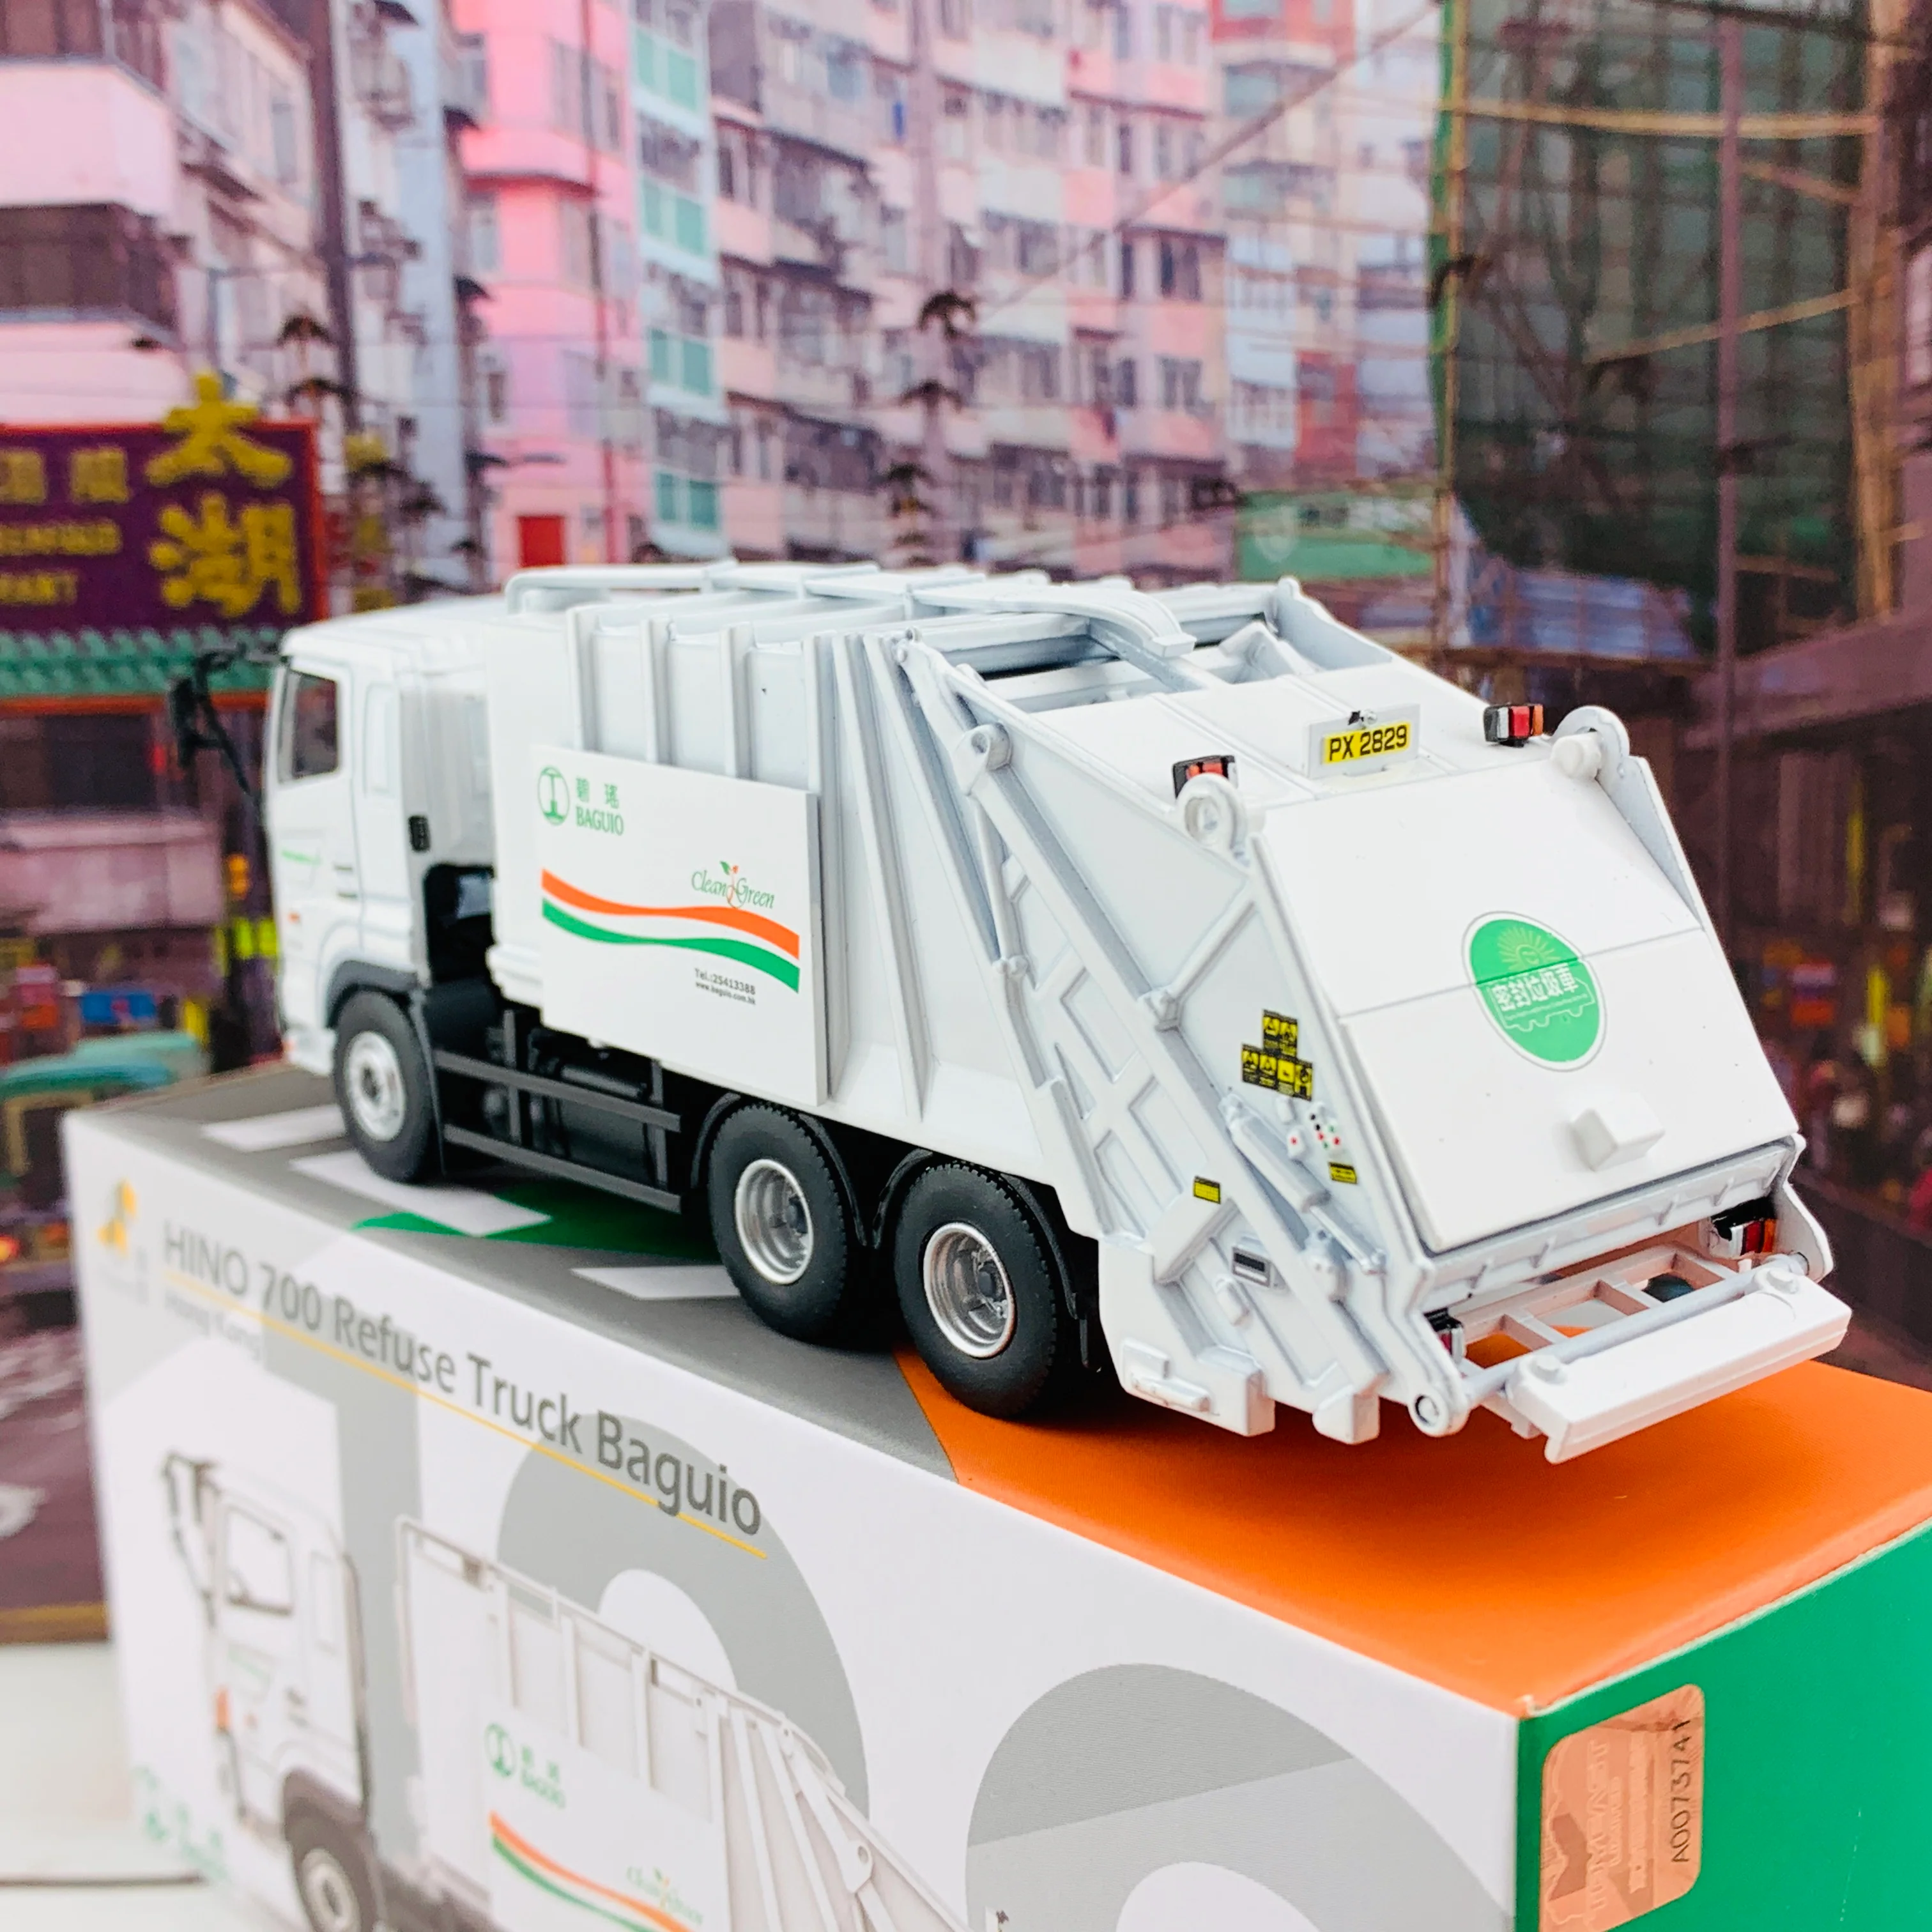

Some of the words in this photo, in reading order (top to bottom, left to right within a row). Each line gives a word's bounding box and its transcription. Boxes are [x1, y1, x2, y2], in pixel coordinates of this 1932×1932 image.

[1329, 734, 1354, 762] PX
[1359, 724, 1408, 756] 2829
[576, 806, 624, 836] BAGUIO
[691, 870, 726, 897] Clean
[735, 878, 775, 909] Green
[163, 1219, 249, 1296] HINO
[258, 1262, 321, 1331] 700
[334, 1296, 456, 1395] Refuse
[468, 1352, 582, 1453] Truck
[597, 1410, 762, 1536] Baguio
[1671, 1720, 1692, 1863] A0073741
